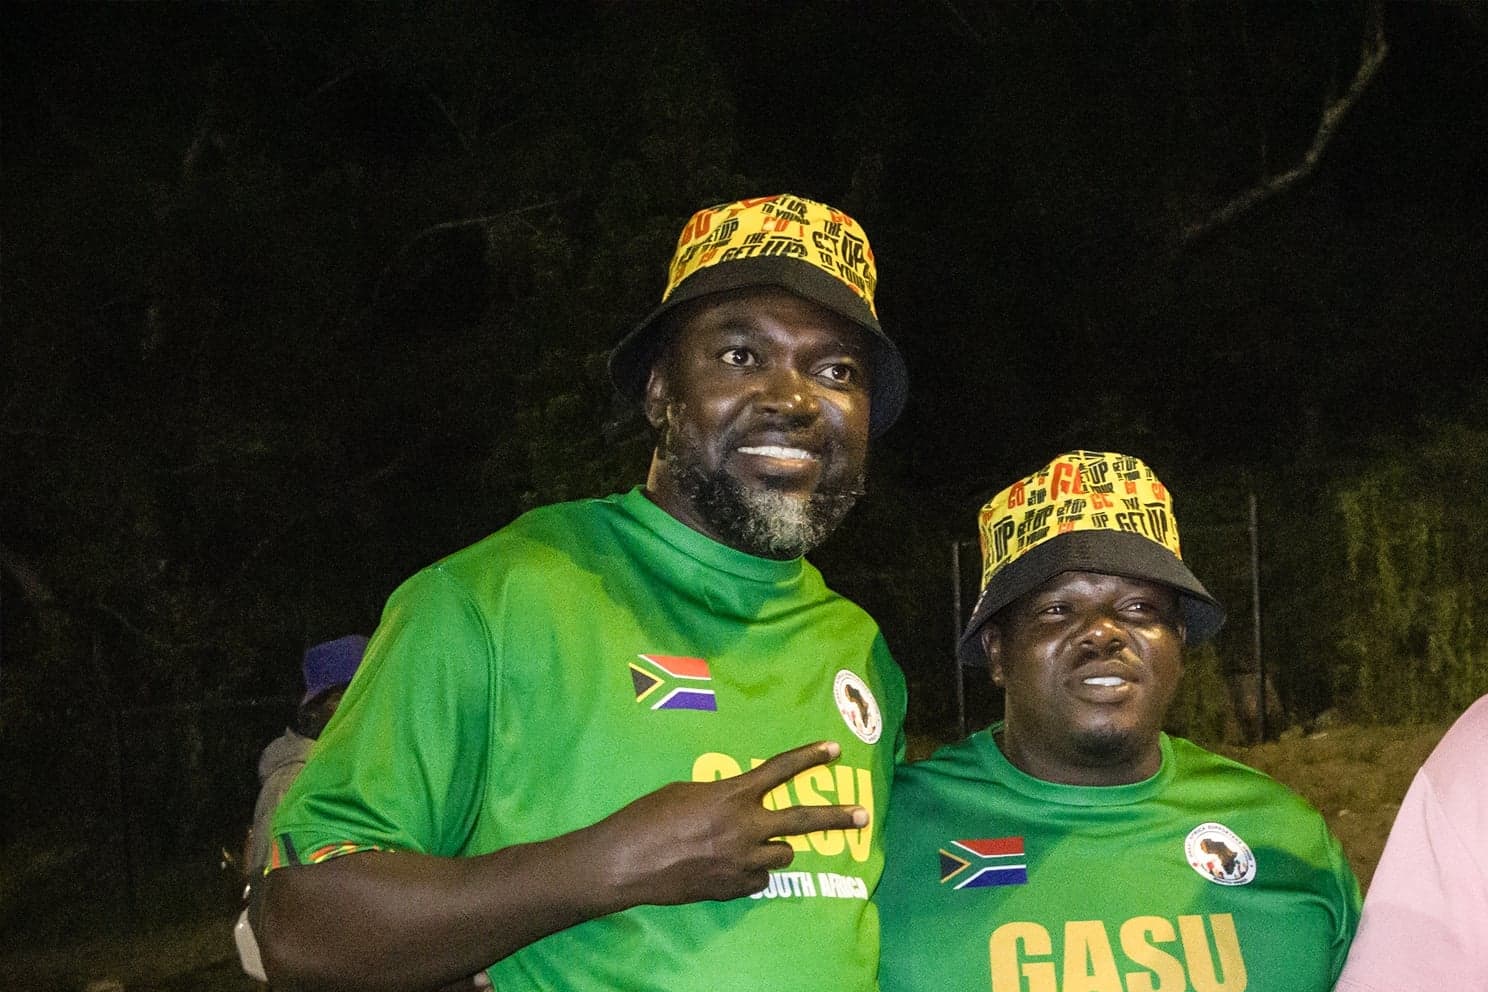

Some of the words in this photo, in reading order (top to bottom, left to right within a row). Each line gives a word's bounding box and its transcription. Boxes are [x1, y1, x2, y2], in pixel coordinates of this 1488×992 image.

[824, 220, 842, 238] THE
[1089, 462, 1108, 484] UP
[1091, 513, 1109, 528] UP
[749, 871, 817, 899] OUTH
[817, 872, 869, 900] AFRICA
